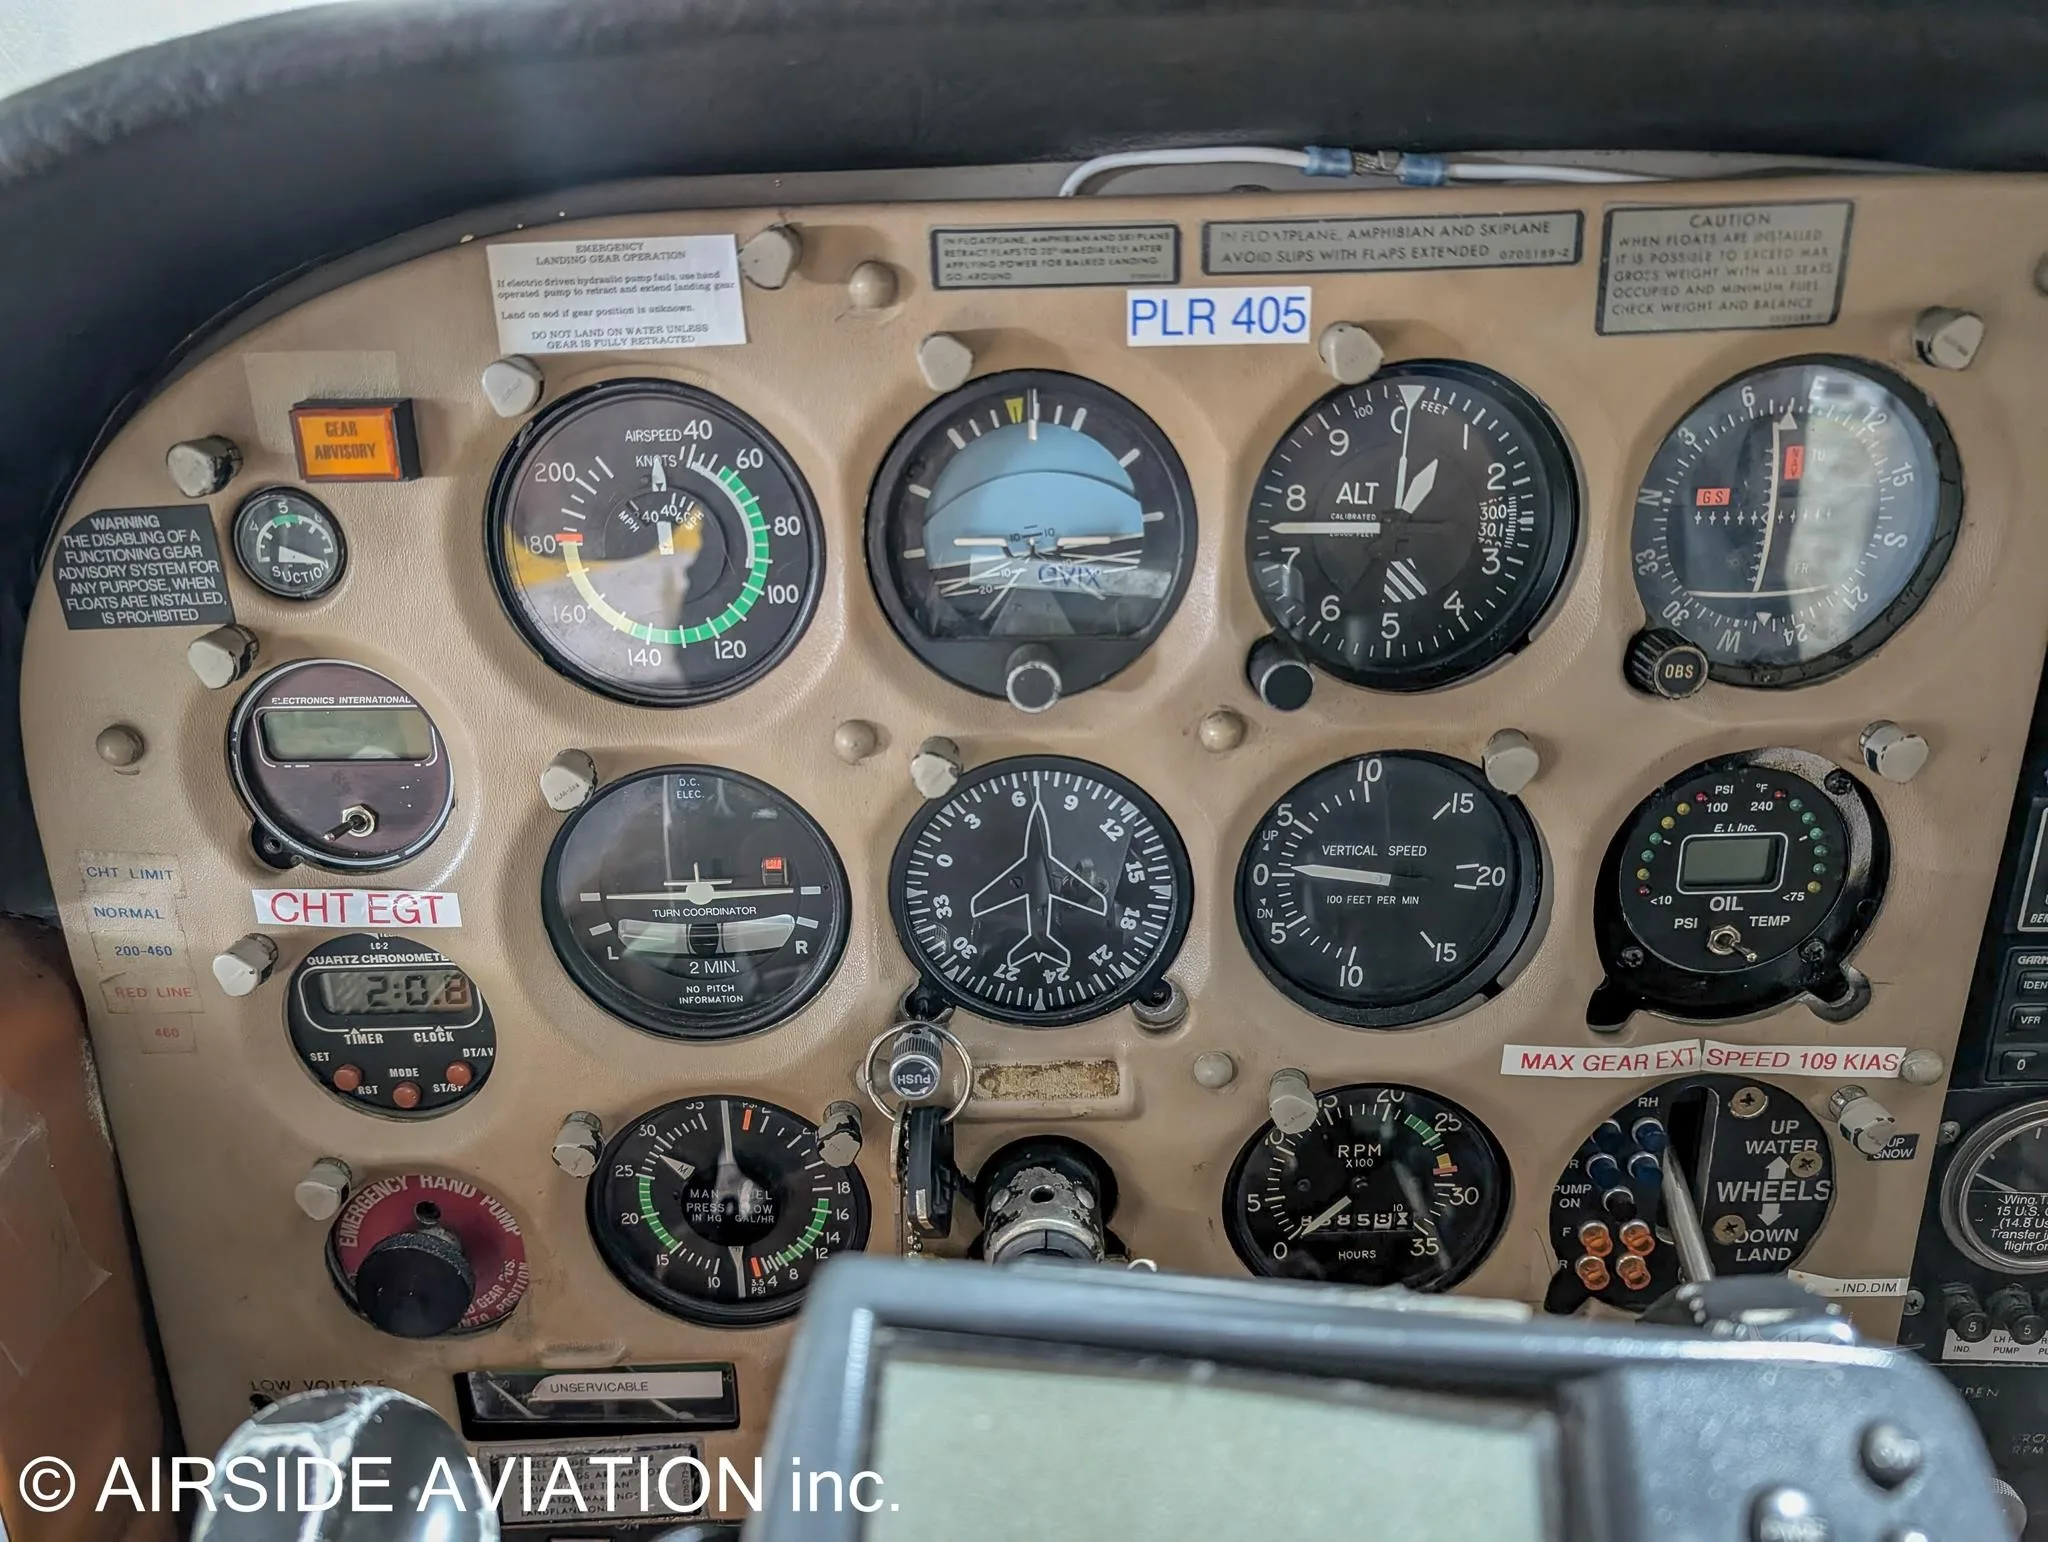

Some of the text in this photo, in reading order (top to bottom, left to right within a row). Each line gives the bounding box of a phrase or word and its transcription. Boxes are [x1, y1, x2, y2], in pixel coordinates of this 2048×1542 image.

[1689, 213, 1771, 228] CAUTION
[1346, 221, 1551, 240] AMPHIBIAN AND SKIPLANE
[1619, 232, 1747, 247] WHEN FLOATS ARE
[576, 242, 644, 253] EMERGENCY
[536, 251, 686, 265] LANDING GEAR OPERATION
[1222, 245, 1489, 265] AVOID SLIPS WITH FLAPS EXTENDED
[1612, 298, 1813, 315] CHECK WEIGHT AND BALANCE
[1132, 296, 1306, 336] PLR 405
[532, 324, 708, 340] DO NOT LAND ON WATER UNLESS
[547, 336, 695, 349] GEAR IS FULLY RETRACTED
[1421, 400, 1448, 416] FEET
[325, 421, 358, 437] GEAR
[625, 429, 682, 441] AIRSPEED
[683, 420, 712, 440] 40
[314, 442, 376, 459] ADVISORY
[736, 448, 763, 468] 60
[535, 463, 576, 482] 200
[1892, 462, 1913, 487] 15
[1336, 482, 1379, 505] ALT
[278, 502, 289, 514] 5
[91, 516, 160, 531] WARNING
[1330, 512, 1376, 521] CALIBRATED
[774, 516, 801, 536] 80
[62, 529, 201, 548] THE DISABLING OF A
[66, 546, 202, 564] FUNCTIONING GEAR
[59, 561, 219, 581] ADVISORY SYSTEM FOR
[272, 559, 329, 584] SUCTION
[70, 577, 216, 595] ANY PURPOSE, WHEN
[66, 592, 228, 611] FLOATS ARE INSTALLED,
[767, 585, 798, 604] 100
[101, 609, 199, 624] IS PROHIBITED
[715, 641, 747, 660] 120
[1665, 664, 1694, 679] OBS
[271, 696, 411, 705] ELECTRONICS INTERNATIONAL
[1357, 759, 1382, 782] 10
[679, 778, 699, 787] D.C.
[1715, 785, 1734, 794] PSI
[677, 790, 705, 799] ELEC.
[1452, 792, 1474, 813] 15
[1706, 802, 1728, 812] 100
[1750, 802, 1773, 811] 240
[1099, 818, 1124, 842] 12
[1262, 830, 1278, 840] UP
[1322, 845, 1427, 856] VERTICAL SPEED
[87, 866, 174, 880] CHT LIMIT
[1476, 866, 1505, 886] 20
[1326, 896, 1419, 904] 100 FEET PER MIN
[1650, 896, 1672, 906] <10
[1710, 896, 1744, 911] OIL
[1782, 892, 1805, 902] <75
[94, 907, 164, 919] NORMAL
[271, 892, 443, 924] CHT EGT
[653, 906, 756, 917] TURN COORDINATOR
[1257, 908, 1274, 918] DN
[1674, 918, 1698, 928] PSI
[1750, 916, 1790, 927] TEMP
[115, 946, 173, 956] 200-460
[370, 942, 388, 950] LC-2
[307, 953, 450, 965] QUARTZ CHRONOMETE
[689, 960, 740, 974] 2 MIN.
[115, 987, 193, 998] RED LINE
[686, 984, 735, 993] NO PITCH
[679, 995, 744, 1004] INFORMATION
[2021, 1016, 2041, 1024] VFR
[155, 1028, 180, 1038] 460
[344, 1031, 454, 1045] TIMER CLOCK
[310, 1052, 329, 1062] SET
[463, 1048, 493, 1058] DT/AV
[1521, 1047, 1899, 1072] MAX GEAR EXT SPEED 109 KIAS
[389, 1068, 420, 1077] MODE
[898, 1074, 931, 1084] PUSH
[358, 1085, 378, 1095] RST
[1771, 1120, 1799, 1135] UP
[1338, 1144, 1381, 1158] RPM
[1745, 1139, 1818, 1154] WATER
[1874, 1149, 1913, 1159] SNOW
[615, 1166, 634, 1176] 25
[1450, 1187, 1479, 1205] 30
[1553, 1184, 1592, 1195] PUMP
[1718, 1181, 1832, 1202] WHEELS
[686, 1202, 726, 1213] PRESS
[1559, 1198, 1581, 1208] ON
[339, 1175, 522, 1248] EMERGENCY HAND PUMP
[692, 1214, 722, 1223] IN HG
[734, 1214, 774, 1224] GAL/HR
[1991, 1229, 2041, 1239] Transfer
[2005, 1241, 2033, 1252] flight
[1338, 1250, 1376, 1259] HOURS
[1735, 1247, 1791, 1261] LAND
[1842, 1282, 1898, 1294] IND.DIM
[550, 1380, 649, 1394] UNSERVICABLE
